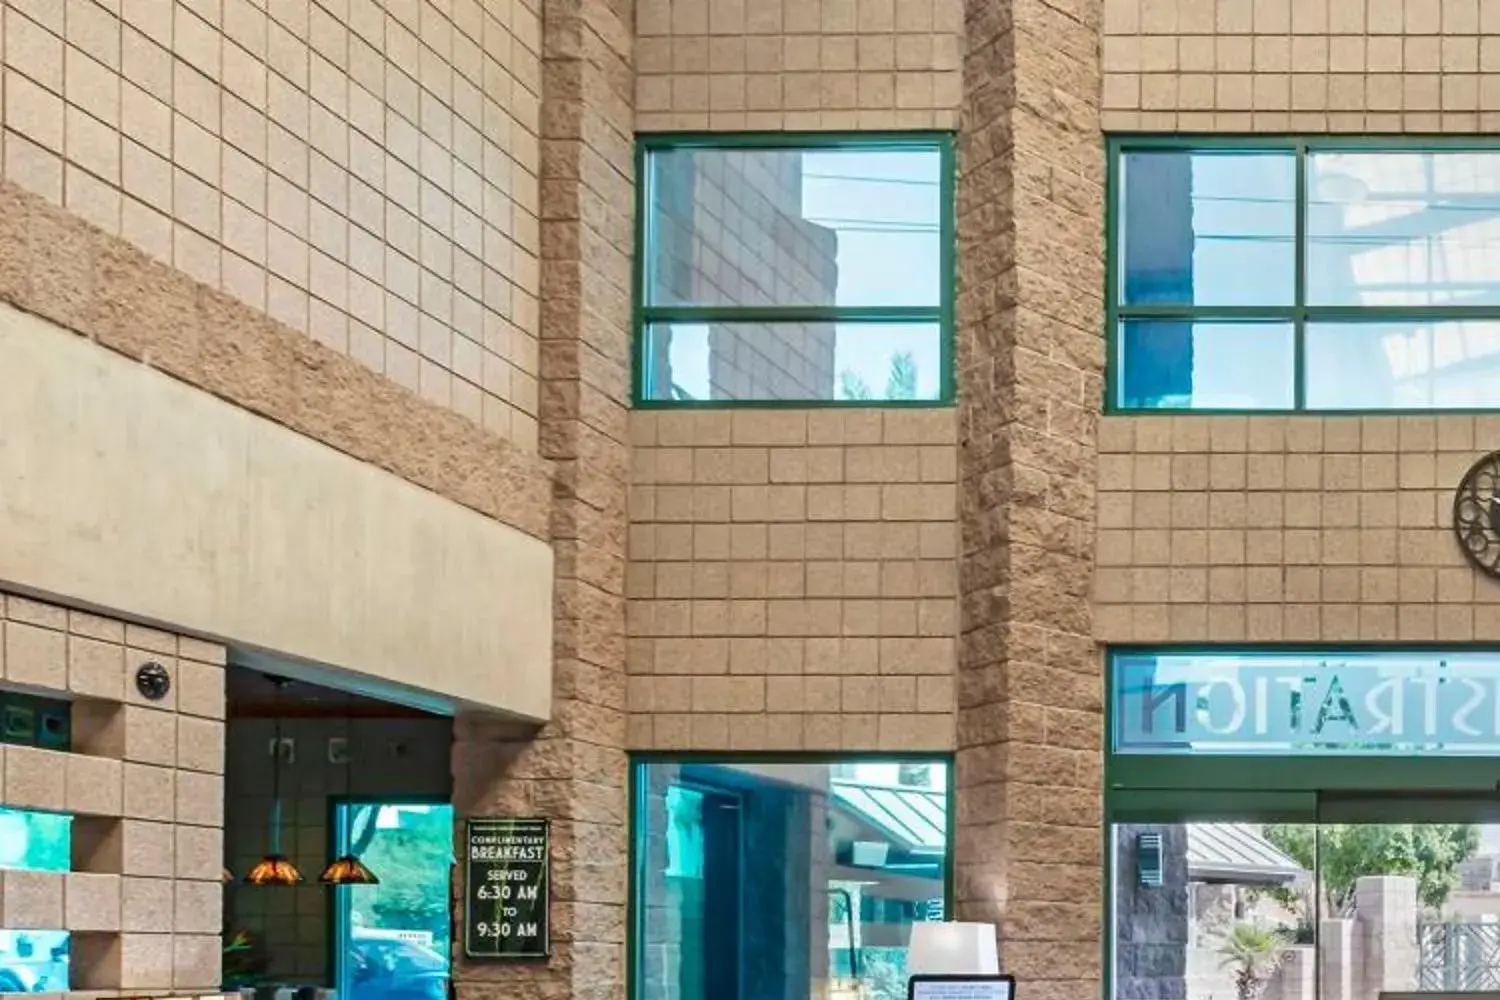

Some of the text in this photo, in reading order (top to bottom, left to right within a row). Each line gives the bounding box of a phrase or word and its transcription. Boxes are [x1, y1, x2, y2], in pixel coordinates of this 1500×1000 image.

[471, 845, 545, 859] BREAKFAST
[487, 869, 528, 881] SERVED
[477, 885, 539, 900] 6:30 AM
[502, 906, 518, 917] TO
[477, 922, 538, 937] 9:30 AM
